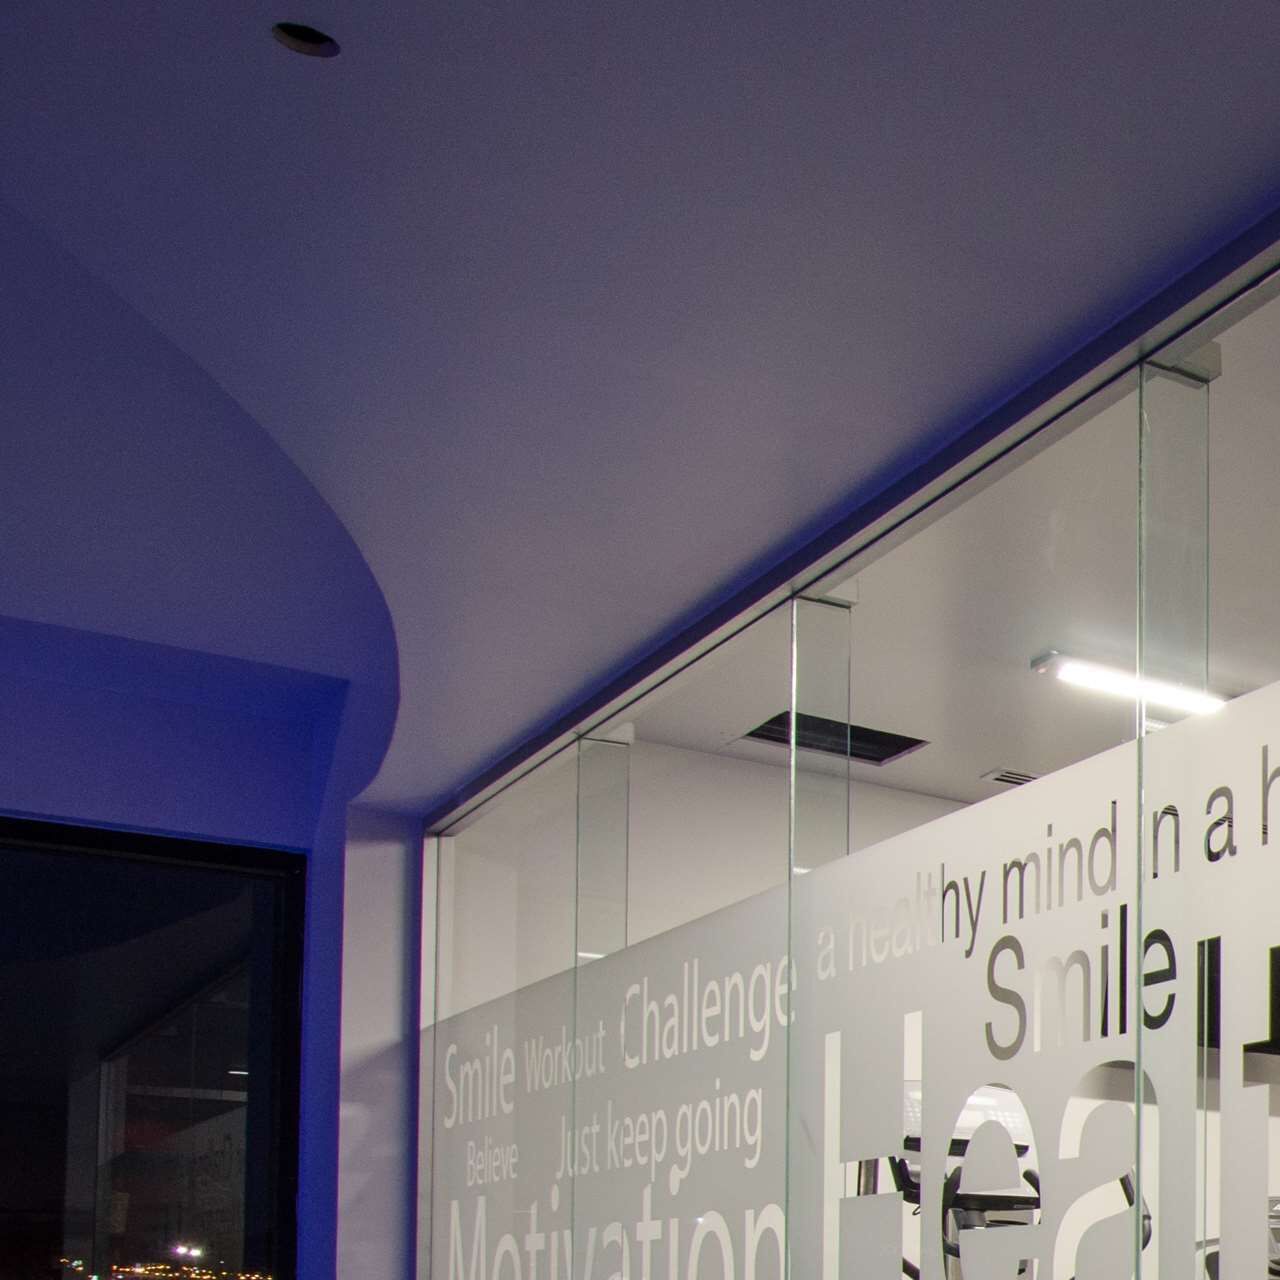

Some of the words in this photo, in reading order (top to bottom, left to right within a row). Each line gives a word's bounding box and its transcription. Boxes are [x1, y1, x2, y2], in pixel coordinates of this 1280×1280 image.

[817, 926, 836, 981] a
[849, 862, 987, 974] healthy
[1002, 800, 1118, 925] mind
[1203, 785, 1238, 863] a
[444, 1024, 517, 1129] Smile
[524, 1019, 607, 1093] Workout
[621, 953, 798, 1070] Challenge
[985, 903, 1178, 1062] Smile
[466, 1136, 519, 1188] Believe
[556, 1111, 601, 1180] Just
[607, 1100, 668, 1182] keep
[675, 1077, 763, 1178] going
